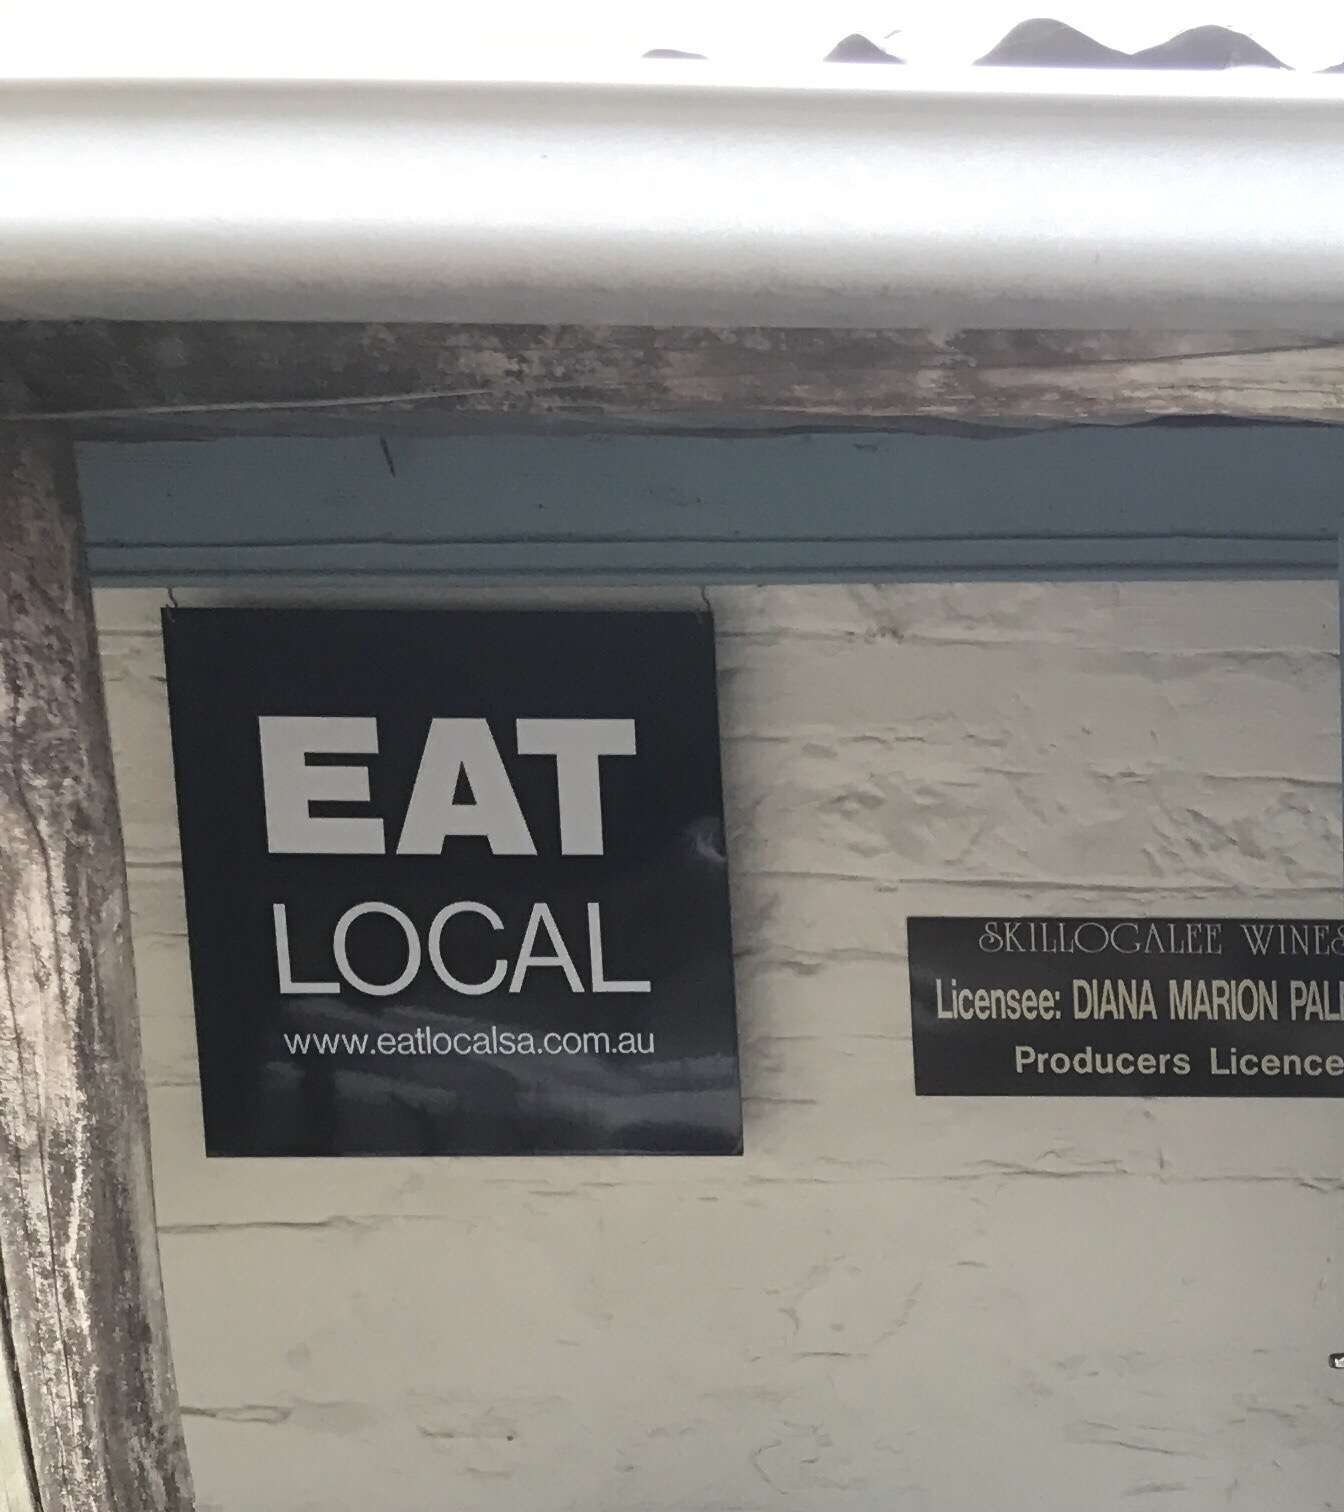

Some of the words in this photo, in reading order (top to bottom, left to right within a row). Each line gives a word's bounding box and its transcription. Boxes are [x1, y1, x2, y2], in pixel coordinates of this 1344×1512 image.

[258, 716, 637, 855] EAT
[272, 901, 651, 996] LOCAL
[978, 921, 1222, 955] SKILLOGALEE
[935, 978, 1061, 1020] Licensee:
[1072, 978, 1158, 1020] DIANA
[1168, 978, 1279, 1022] MARION
[283, 1026, 655, 1056] www.eatlocalsa.com.au
[1015, 1045, 1191, 1075] Producers
[1210, 1047, 1344, 1076] Licence
